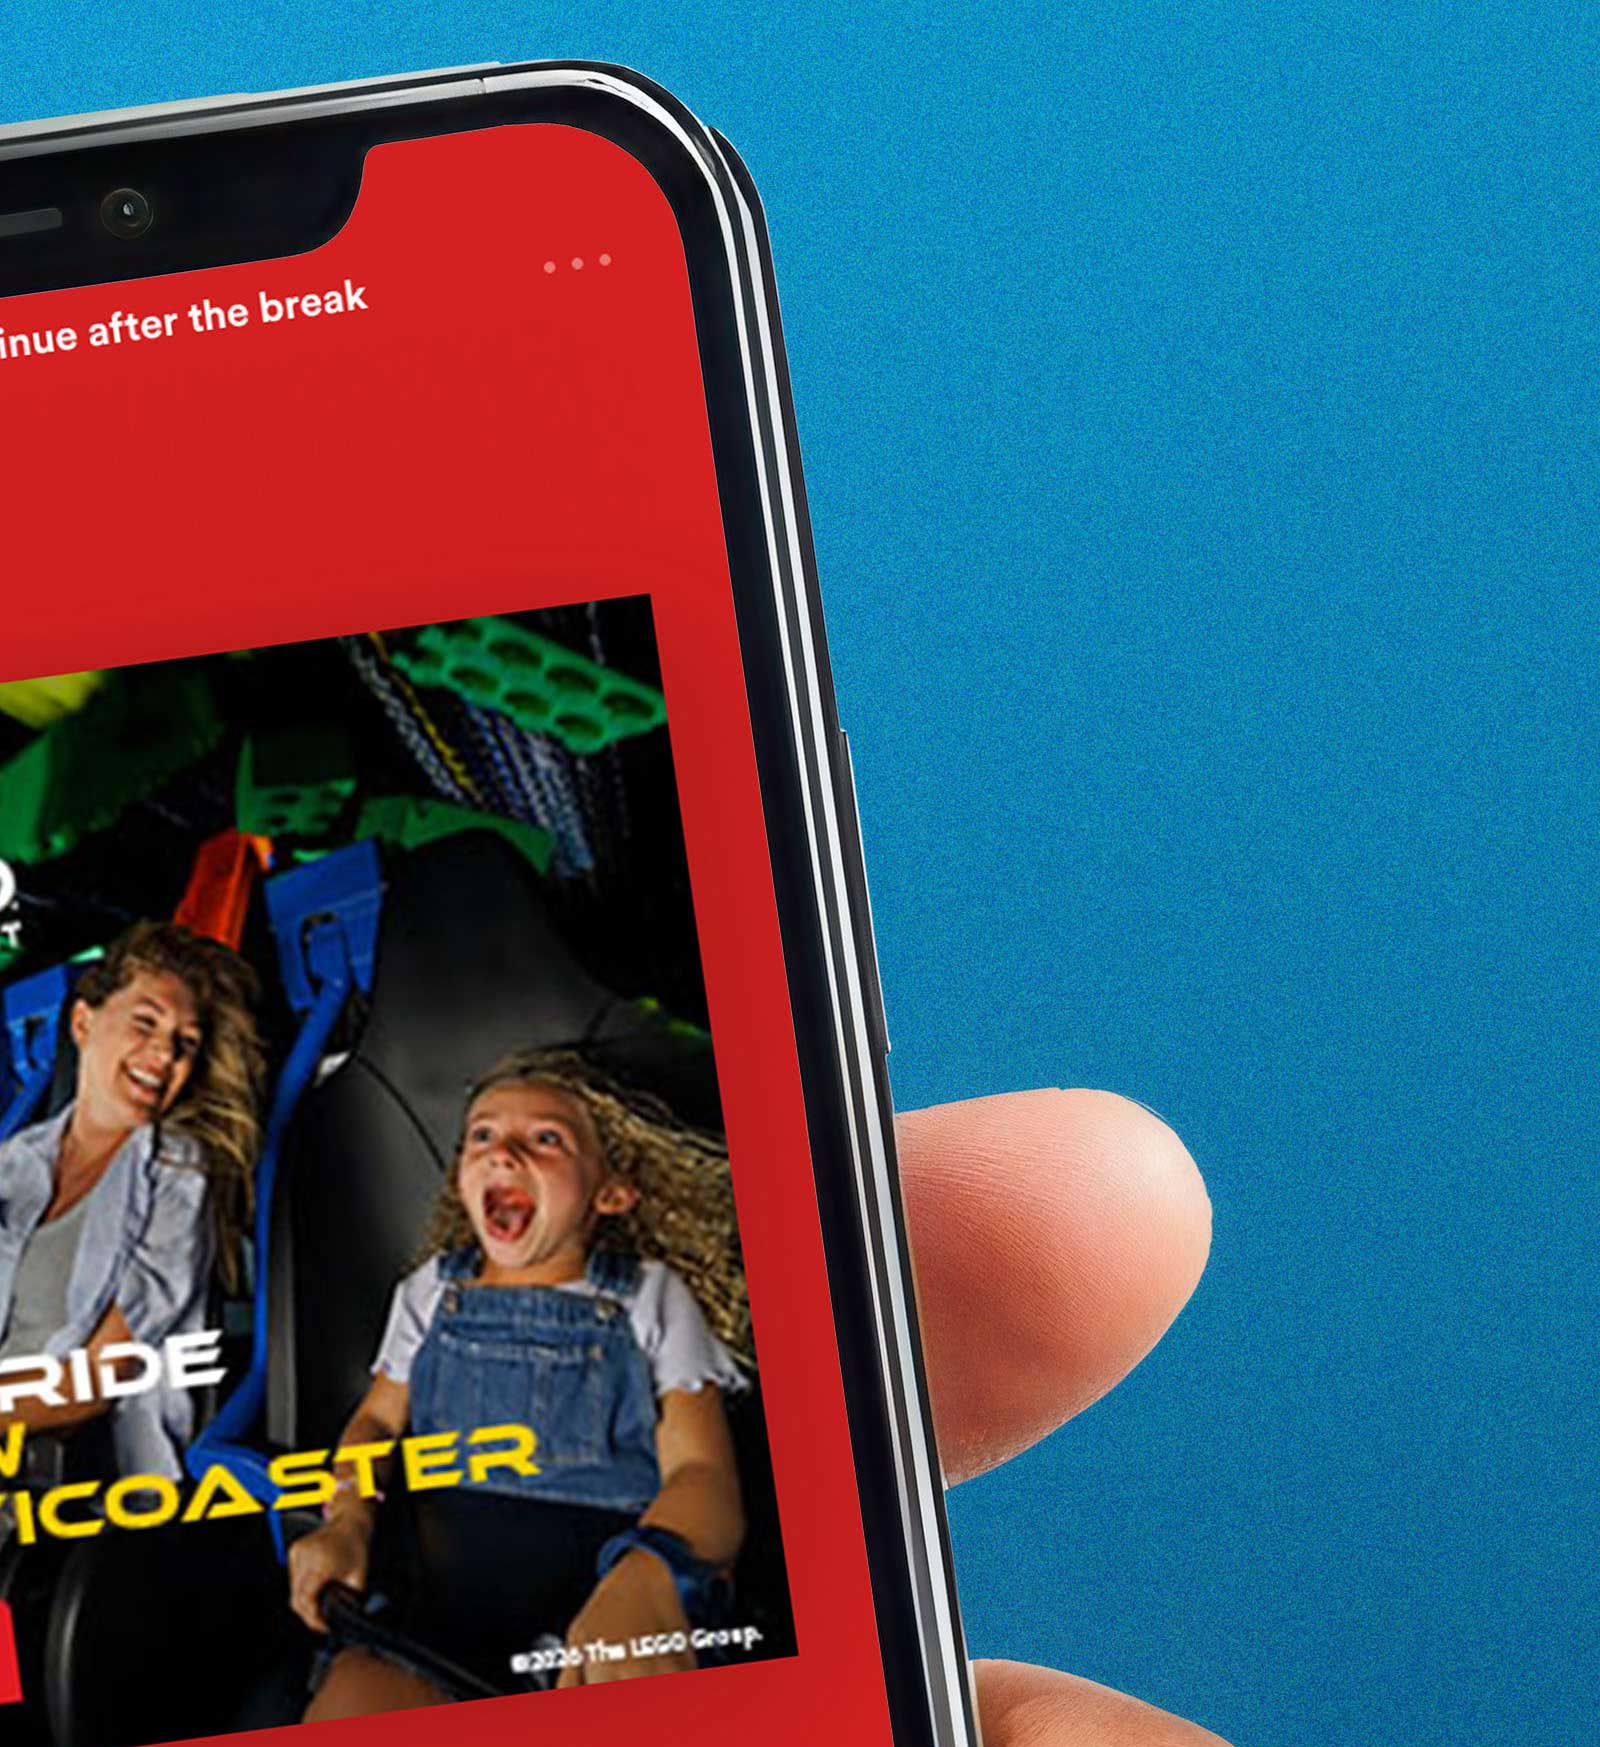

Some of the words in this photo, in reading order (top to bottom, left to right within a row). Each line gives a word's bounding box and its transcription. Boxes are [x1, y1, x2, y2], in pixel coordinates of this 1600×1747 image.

[88, 308, 179, 347] after
[189, 296, 250, 334] the
[259, 279, 369, 323] break
[584, 1637, 626, 1662] The
[629, 1631, 687, 1657] LEGO
